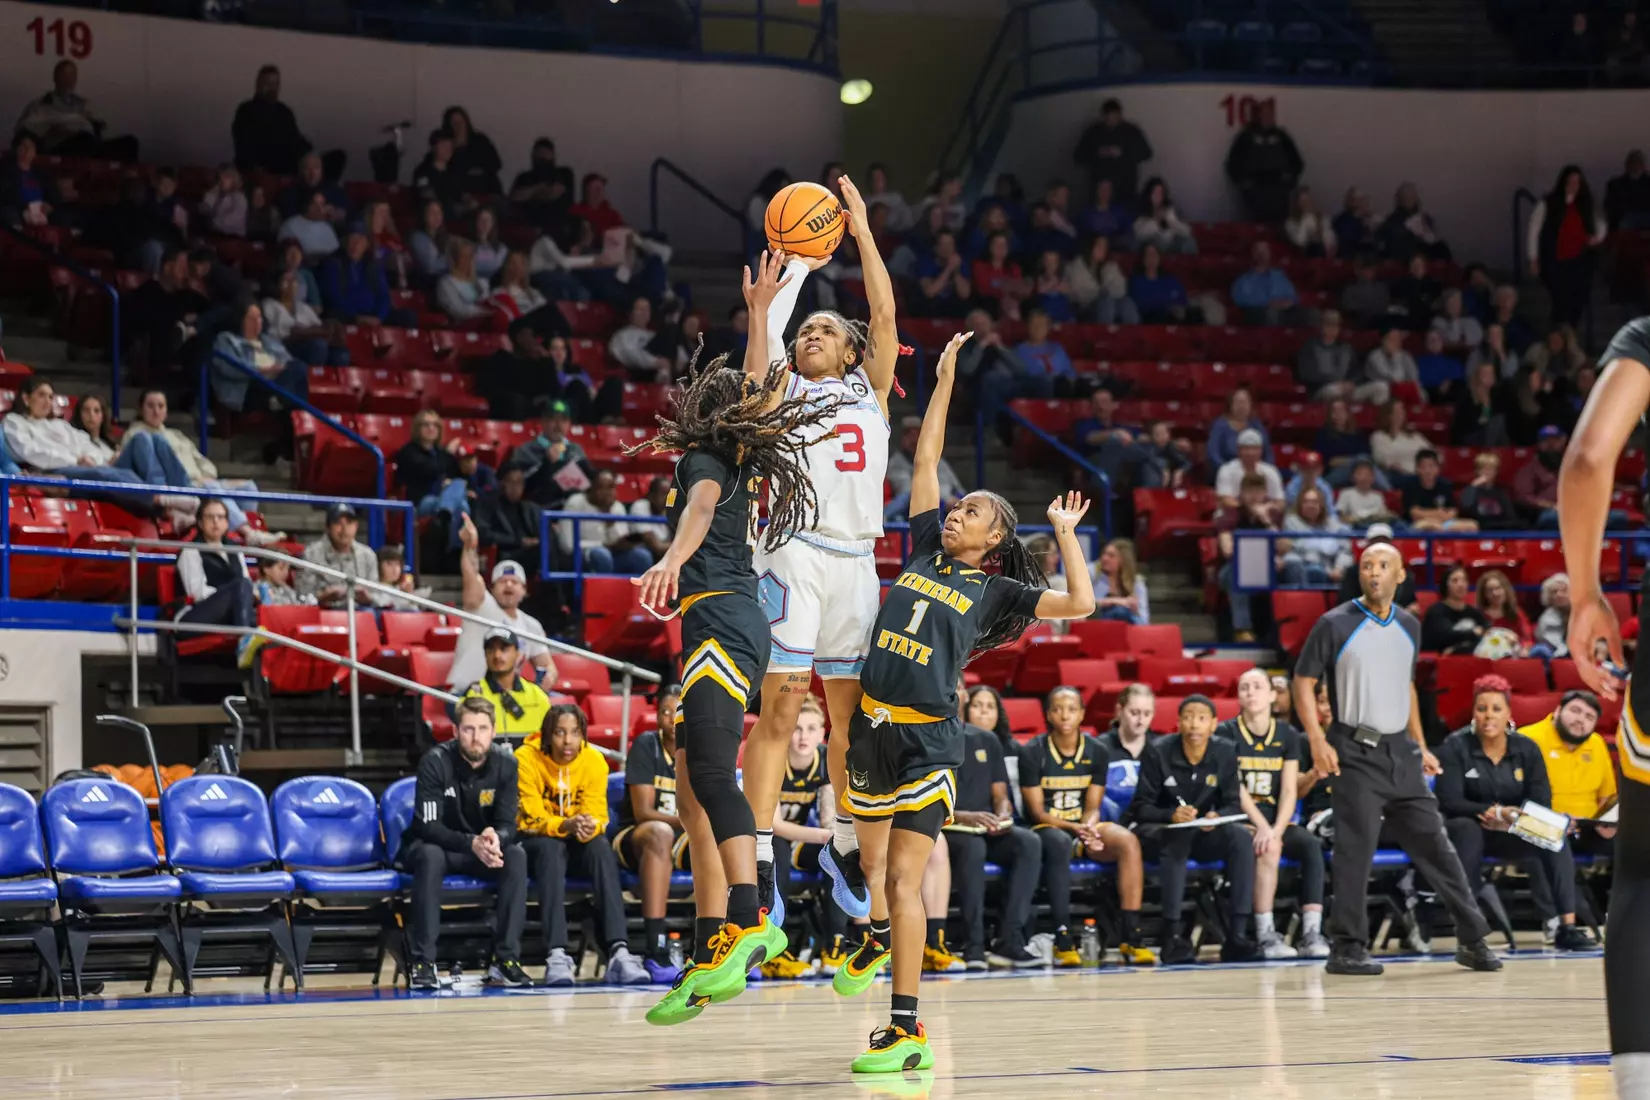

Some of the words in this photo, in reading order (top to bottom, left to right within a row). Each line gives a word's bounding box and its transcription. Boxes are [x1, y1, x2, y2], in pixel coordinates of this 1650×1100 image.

[26, 16, 93, 60] 119
[832, 424, 867, 472] 3
[895, 572, 974, 616] KENNESAW
[904, 598, 930, 635] 1
[876, 628, 934, 666] STATE
[1052, 790, 1082, 809] 15
[1245, 771, 1272, 795] 12
